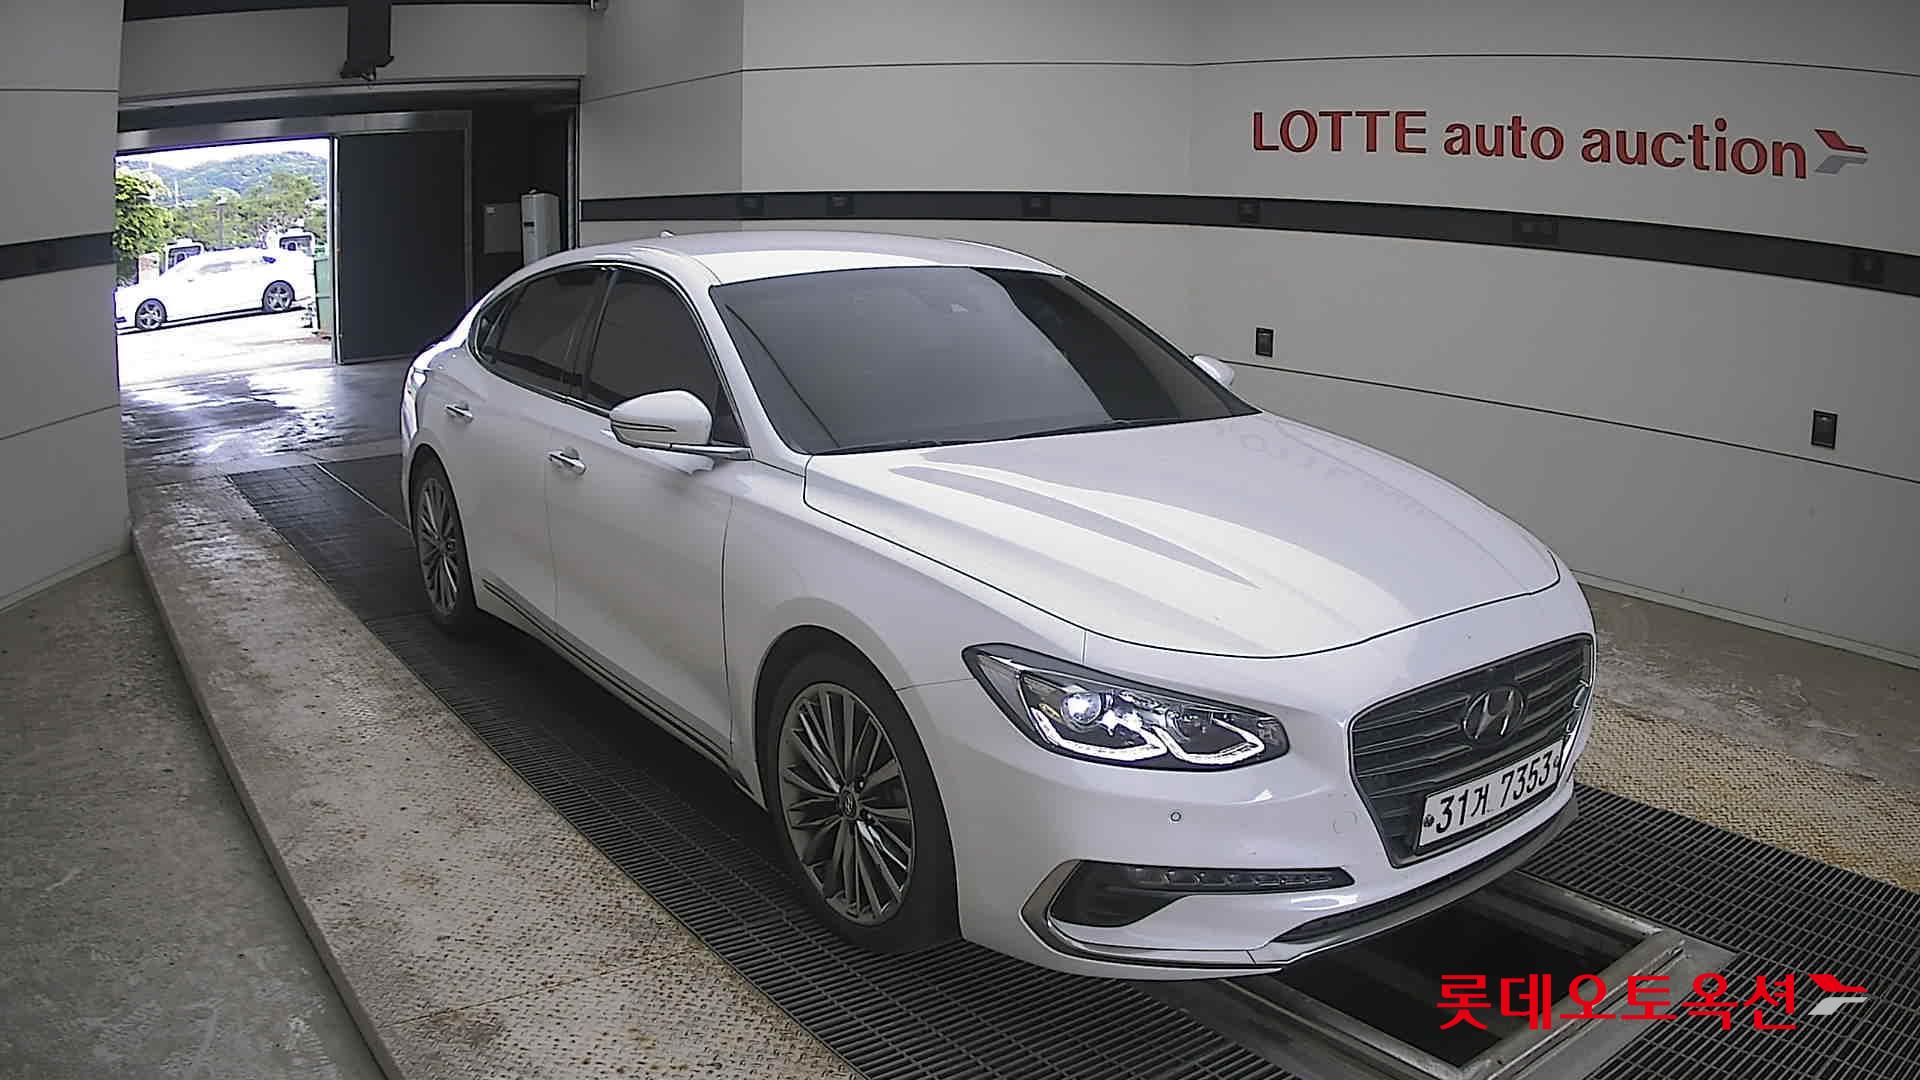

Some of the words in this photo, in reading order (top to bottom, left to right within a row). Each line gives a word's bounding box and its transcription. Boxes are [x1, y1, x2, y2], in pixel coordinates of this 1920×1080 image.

[1252, 110, 1428, 153] LOTTE
[1443, 116, 1564, 160] auto
[1581, 117, 1807, 178] auction
[1436, 783, 1490, 834] 31거
[1500, 750, 1554, 808] 7353
